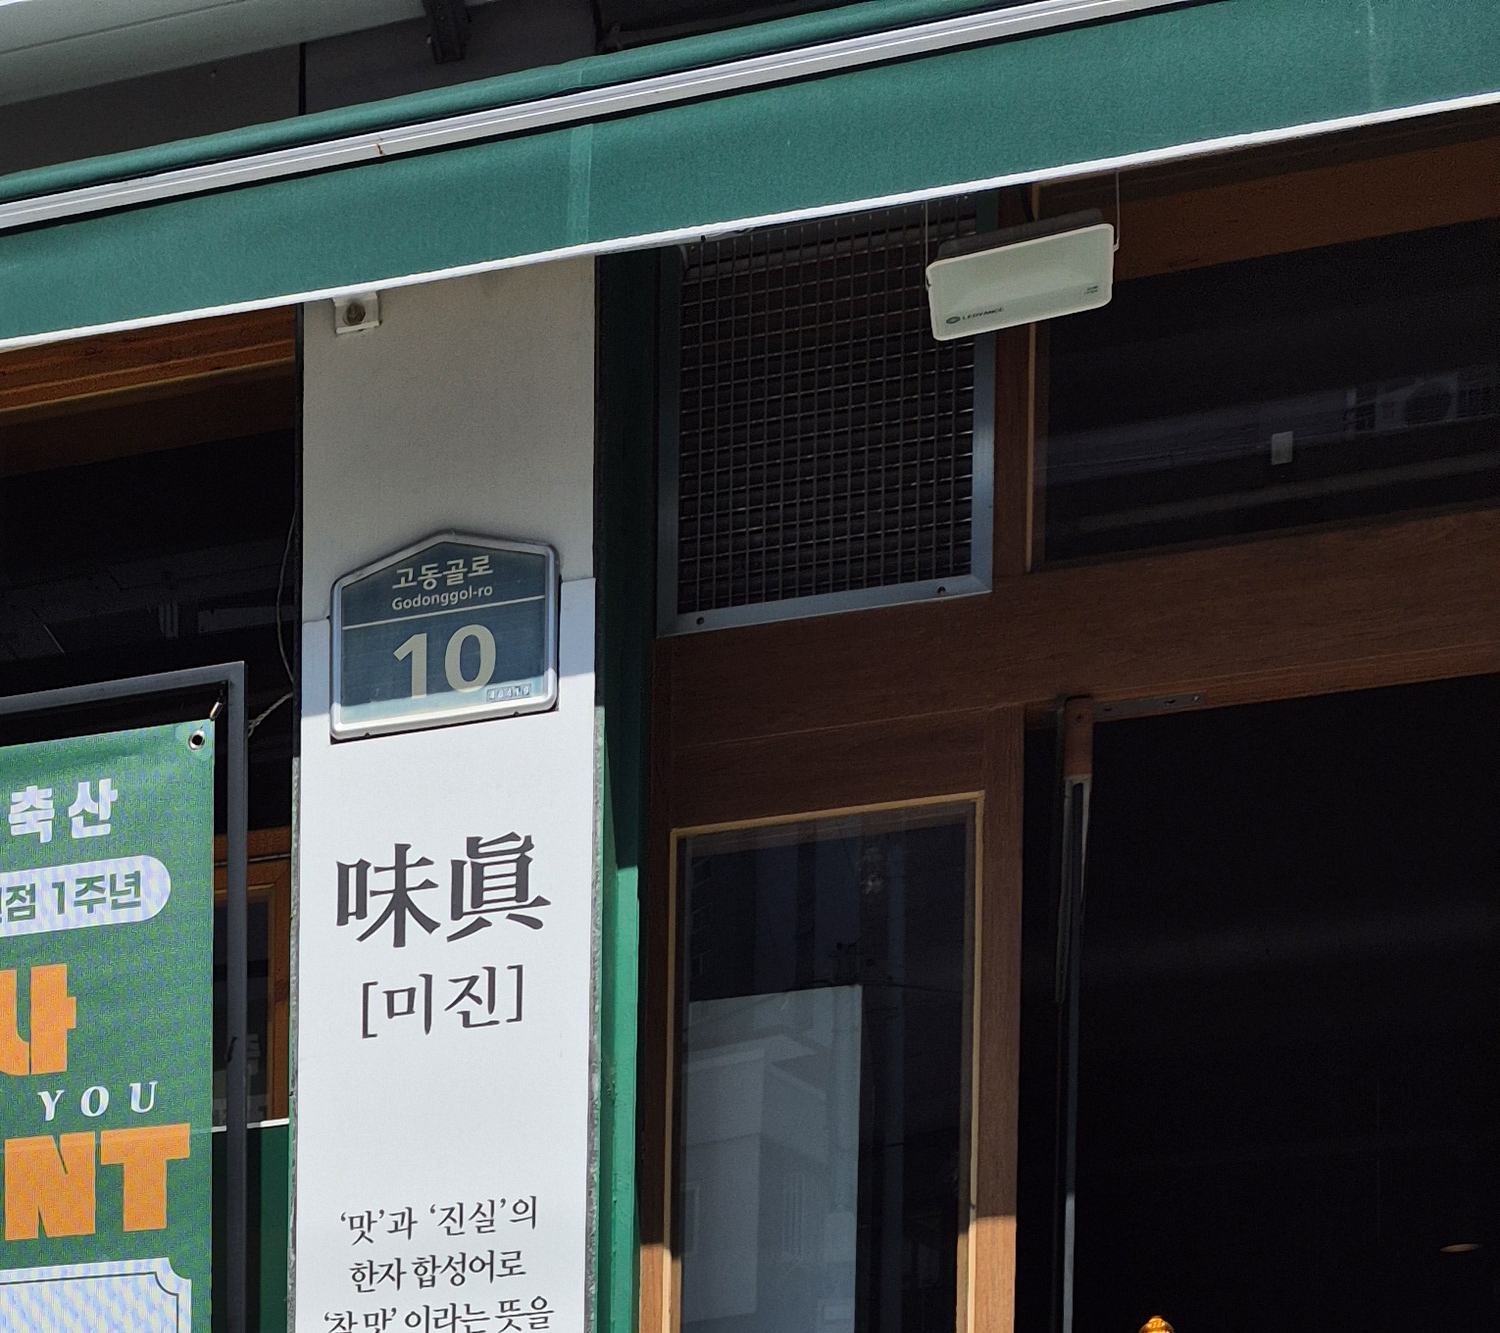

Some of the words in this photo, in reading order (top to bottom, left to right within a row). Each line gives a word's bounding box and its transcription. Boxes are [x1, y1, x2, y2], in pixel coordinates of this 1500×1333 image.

[392, 555, 494, 591] 고동골로
[392, 584, 493, 611] Godonggol-ro
[393, 625, 496, 699] 10
[52, 870, 142, 917] 1주년
[336, 831, 551, 948] 味眞
[362, 965, 524, 1038] [미진]
[37, 1082, 158, 1122] YOU
[350, 1258, 406, 1293] 한자
[412, 1250, 526, 1287] 합성어로
[495, 1295, 555, 1332] 뜻을
